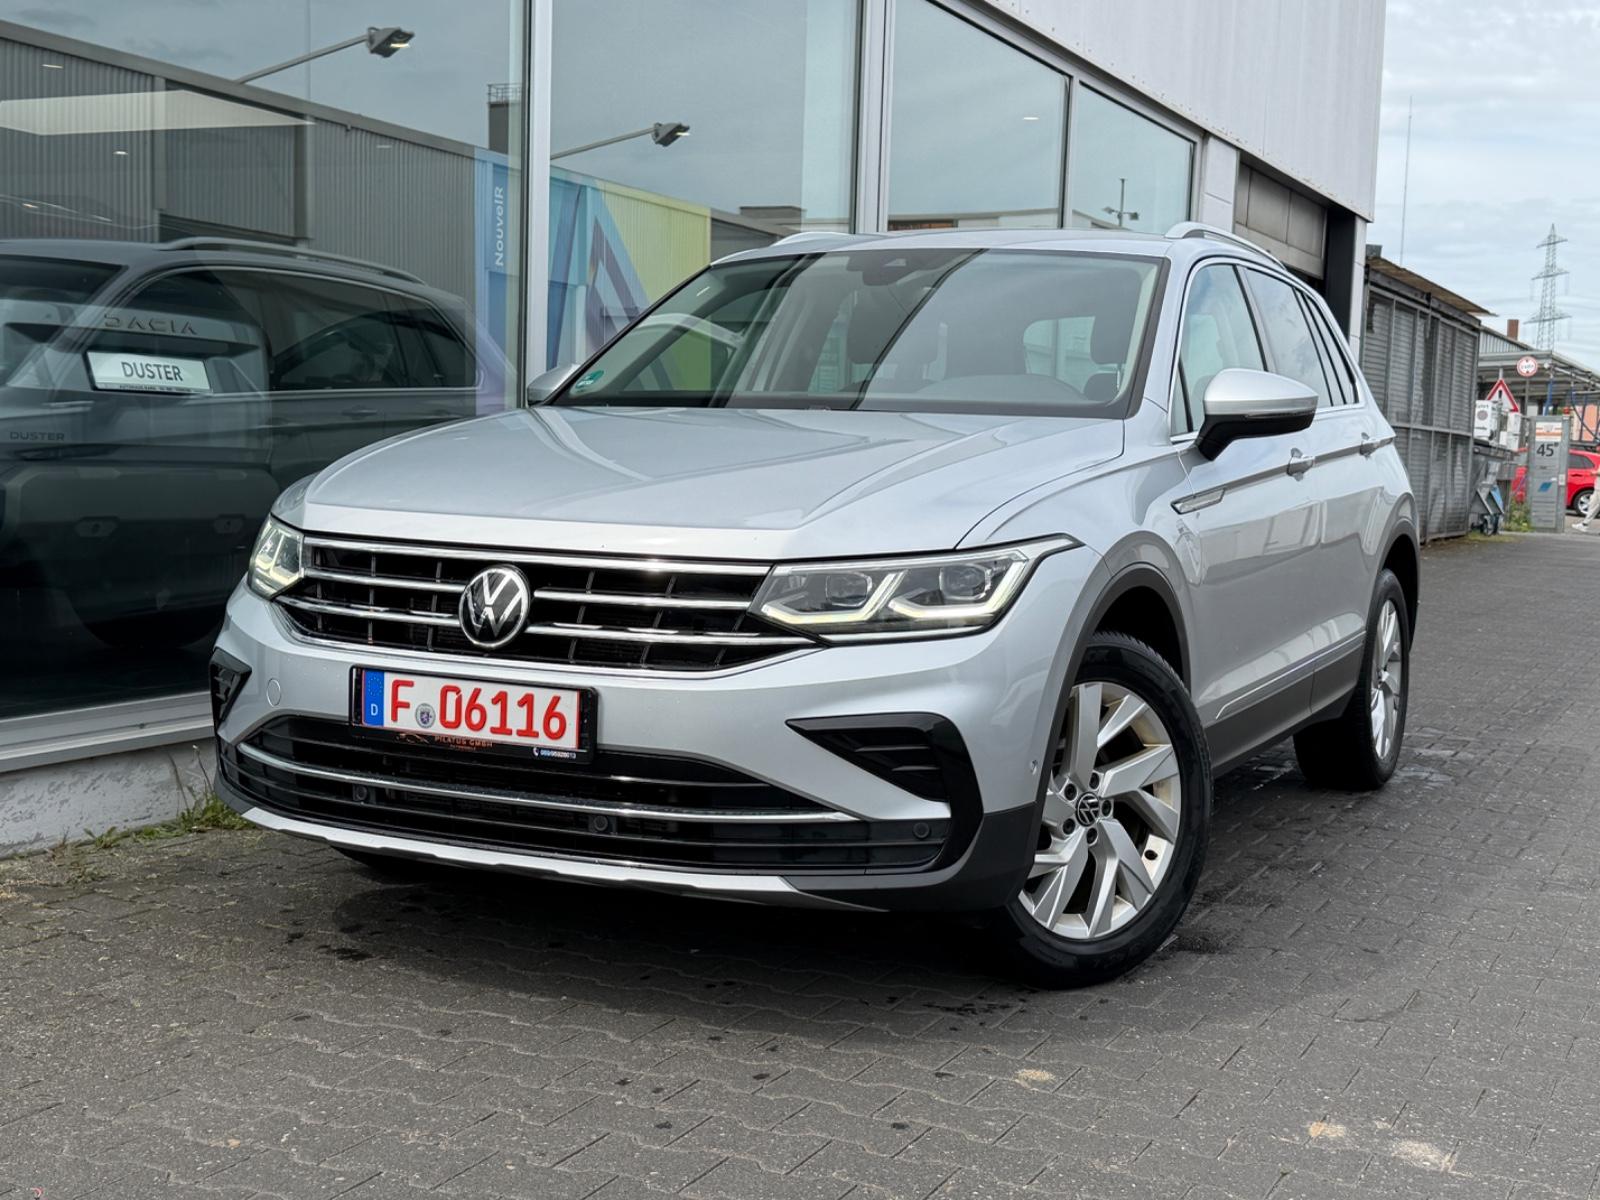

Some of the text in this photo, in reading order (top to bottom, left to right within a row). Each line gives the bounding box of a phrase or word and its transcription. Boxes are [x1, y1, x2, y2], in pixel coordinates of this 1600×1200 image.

[103, 312, 198, 336] DACIA
[121, 361, 183, 382] DUSTER
[9, 431, 65, 441] DUSTER
[370, 703, 379, 717] D
[391, 679, 567, 740] F 06116
